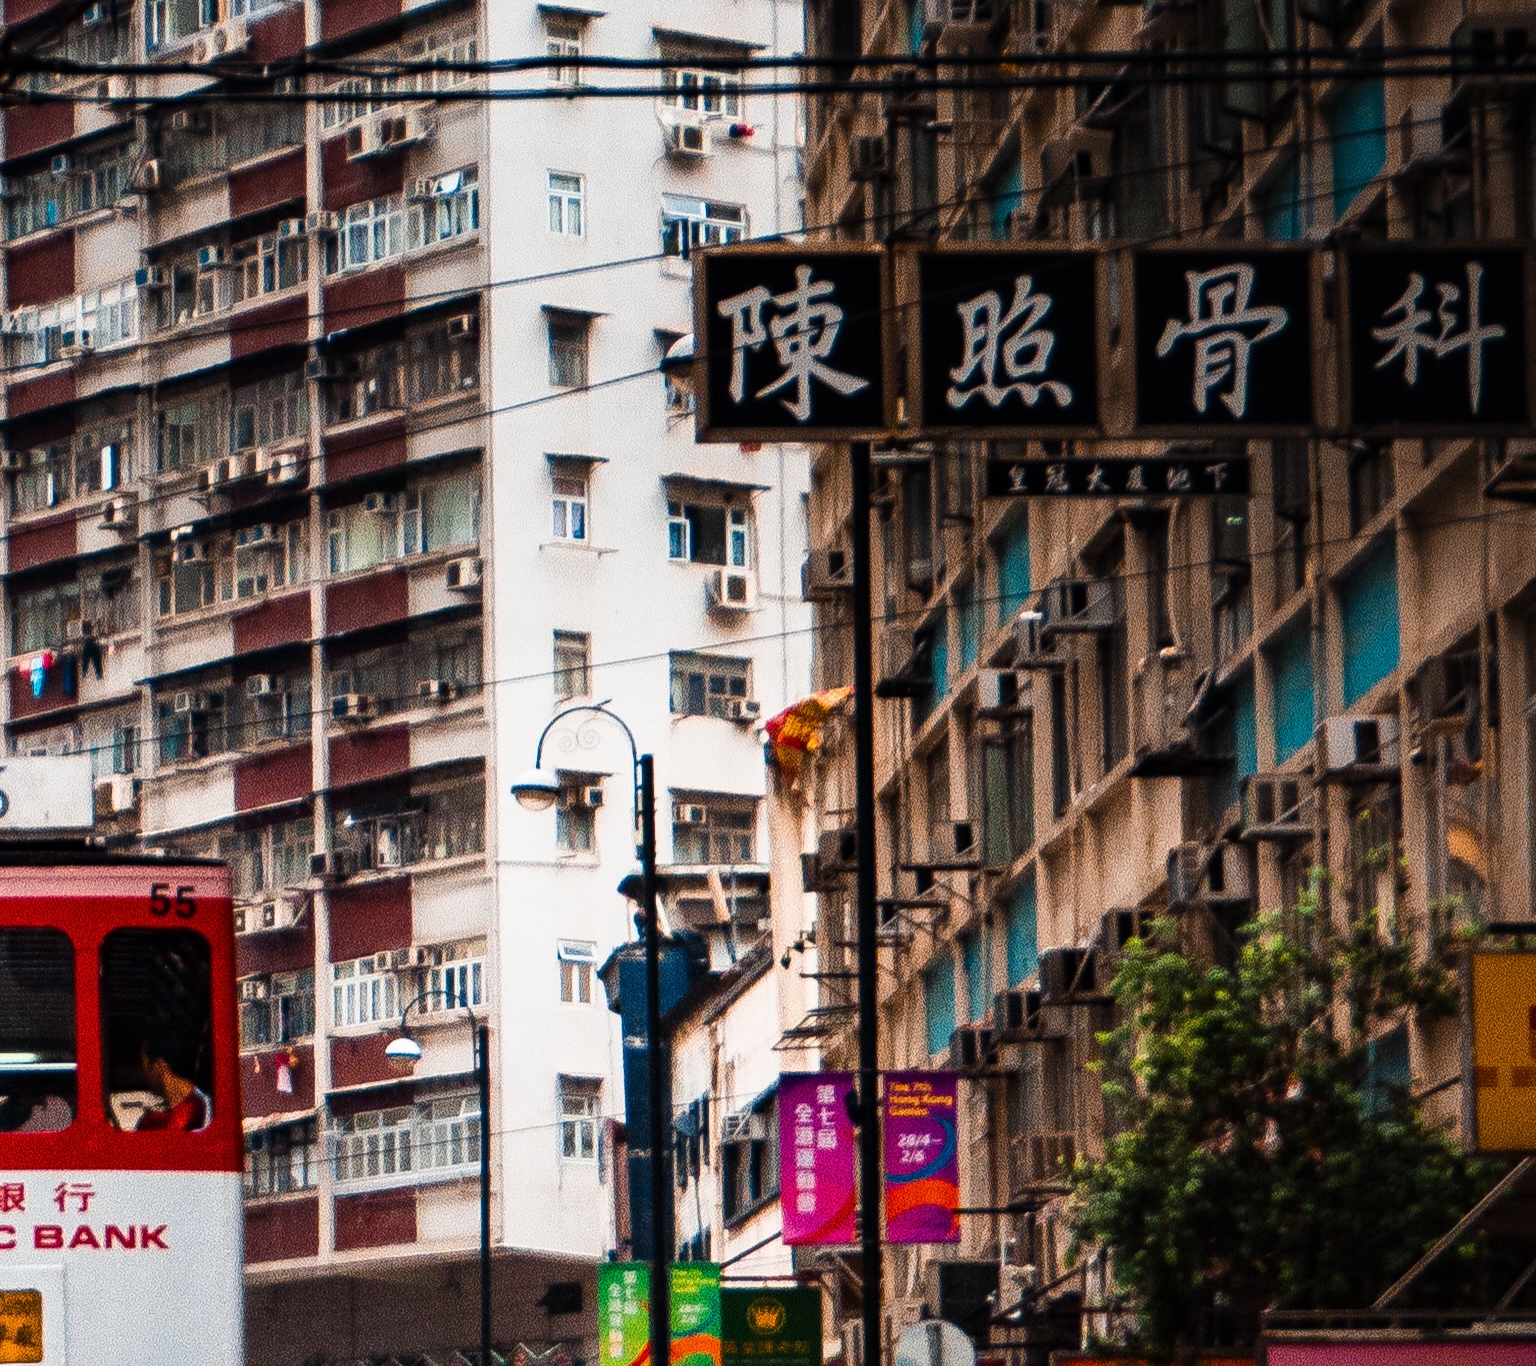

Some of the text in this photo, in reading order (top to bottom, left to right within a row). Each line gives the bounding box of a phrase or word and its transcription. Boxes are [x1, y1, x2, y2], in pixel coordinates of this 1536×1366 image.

[716, 260, 1506, 420] 陳照骨科
[148, 882, 197, 919] 55
[34, 1224, 170, 1250] BANK
